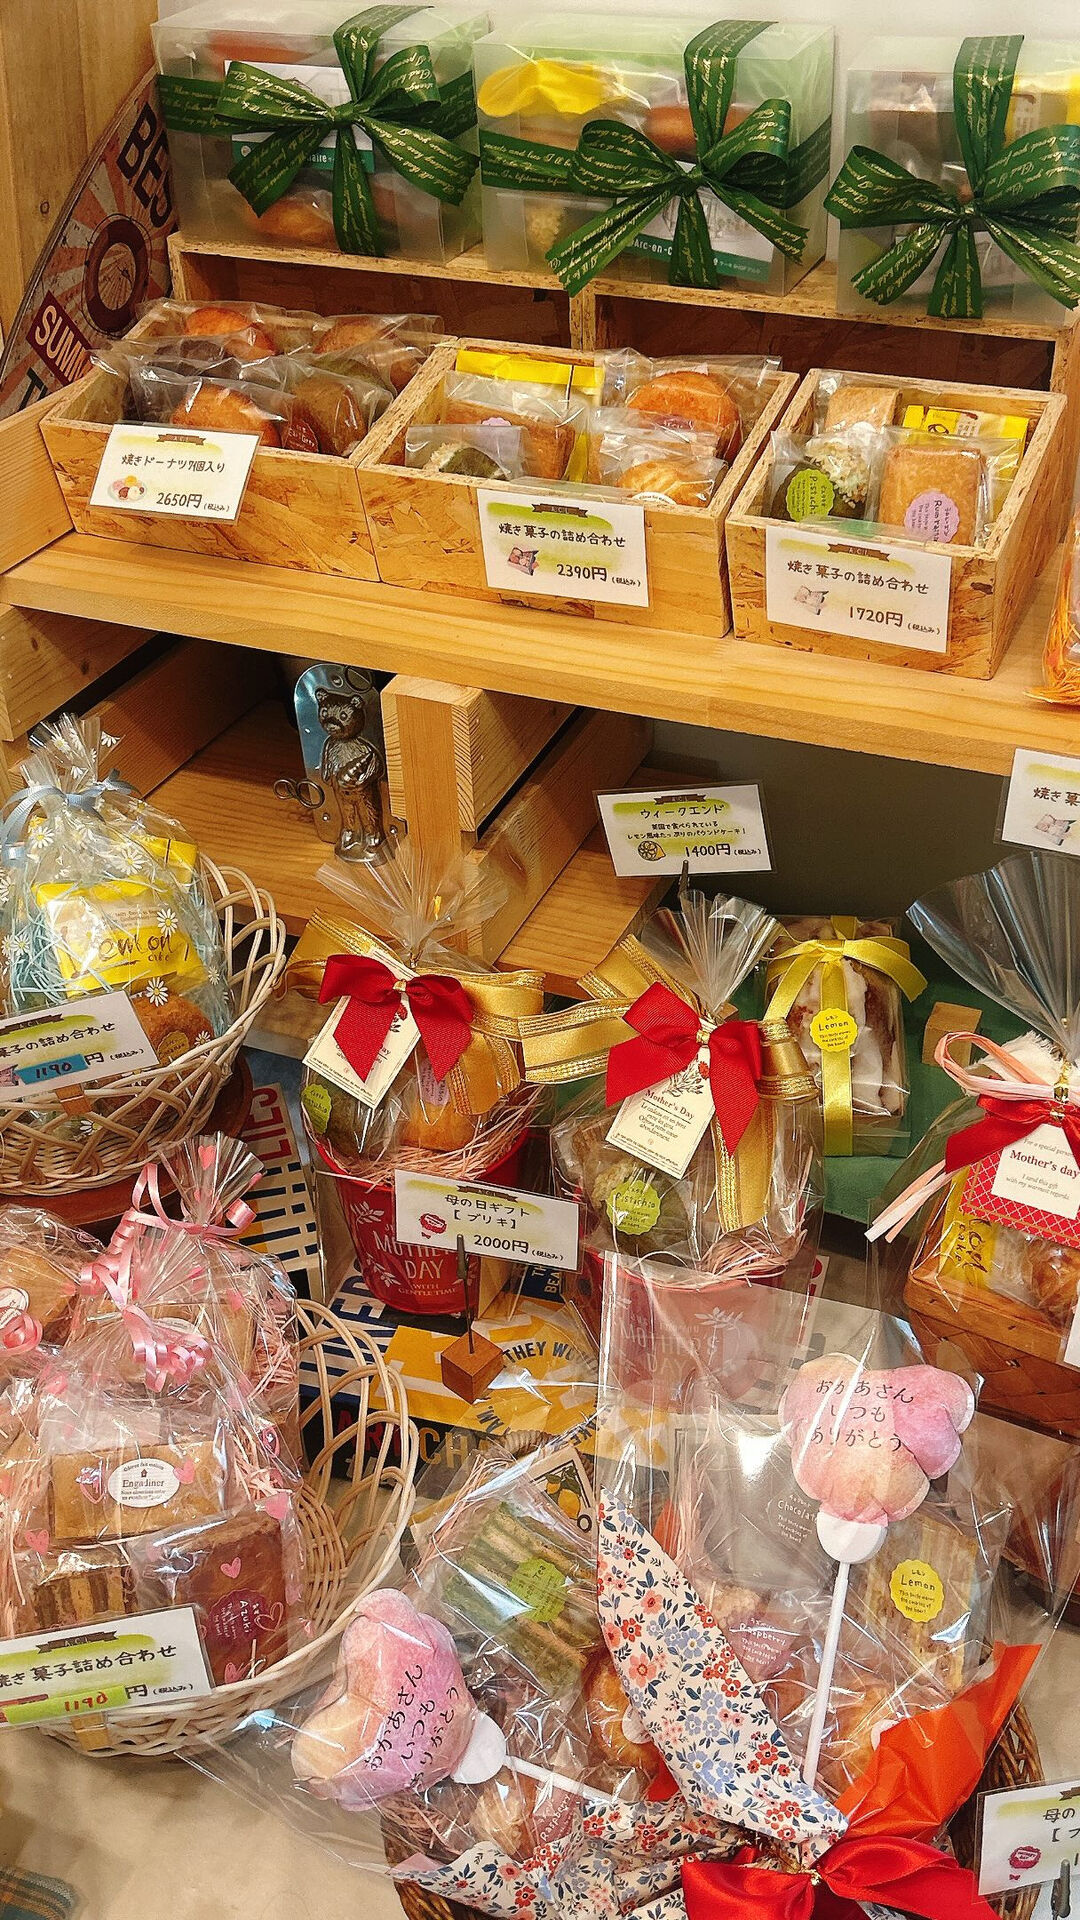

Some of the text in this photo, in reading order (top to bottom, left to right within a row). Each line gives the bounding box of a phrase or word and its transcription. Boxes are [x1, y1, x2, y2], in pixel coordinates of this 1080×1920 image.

[156, 491, 203, 509] 2650円
[498, 522, 626, 548] 焼き菓子の詰め合わせ
[556, 563, 608, 582] 2390円
[787, 559, 930, 595] 焼き菓子の詰め合わせ
[849, 605, 904, 628] 1720円
[640, 804, 725, 820] ウィークエンド
[685, 843, 731, 857] 1400円
[818, 1021, 849, 1032] Lemon
[36, 1061, 73, 1079] 1190
[84, 1051, 105, 1066] 円
[645, 1089, 695, 1121] Mother's Day
[1009, 1149, 1080, 1180] Mother's day
[444, 1193, 531, 1218] 母の日ギフト
[453, 1209, 517, 1230] 【ブリキ】
[473, 1234, 530, 1255] 2000円
[404, 1259, 444, 1280] DAY
[503, 1341, 547, 1364] THEY
[816, 1379, 914, 1404] おかあさん
[811, 1426, 902, 1452] ありがとう
[900, 1574, 936, 1591] Lemon
[239, 1600, 253, 1633] Azuki
[64, 1691, 109, 1712] 1190
[124, 1683, 149, 1700] 円
[364, 1664, 424, 1772] おかあさん
[401, 1699, 436, 1760] いつも
[410, 1686, 460, 1792] ありがとう
[540, 1793, 571, 1842] Raspberry
[1042, 1807, 1076, 1823] 母の
